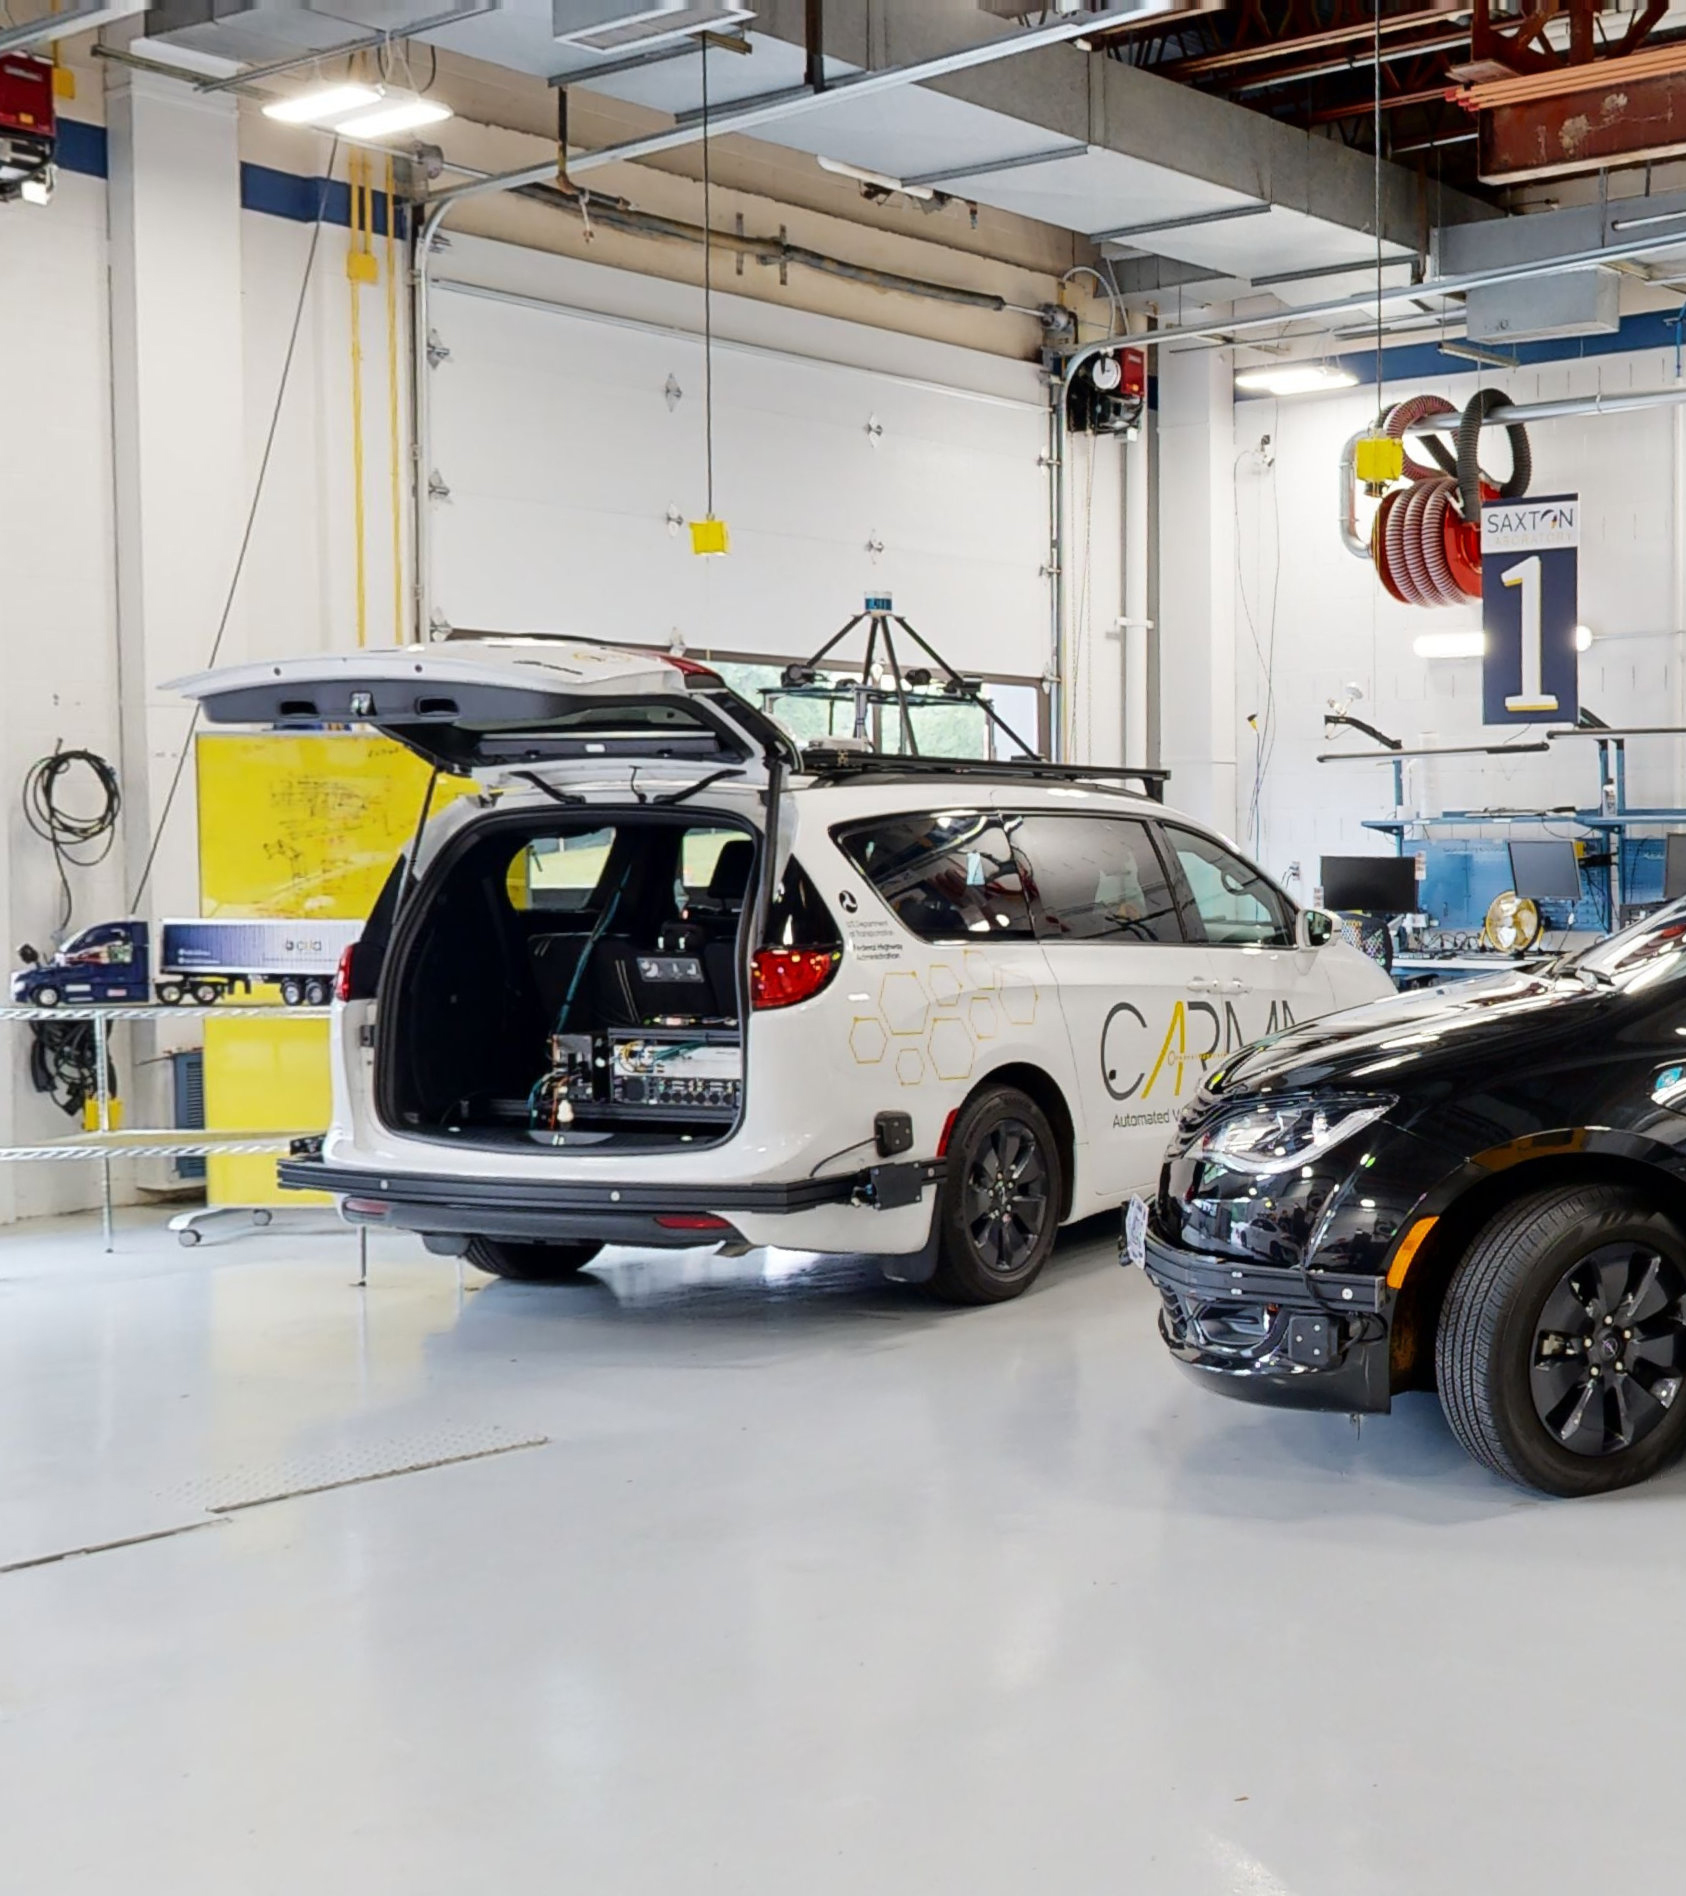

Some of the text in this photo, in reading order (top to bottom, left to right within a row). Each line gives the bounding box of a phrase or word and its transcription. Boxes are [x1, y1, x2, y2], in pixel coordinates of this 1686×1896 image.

[1487, 508, 1573, 534] SAXTON
[1501, 555, 1559, 712] 1
[1101, 1000, 1295, 1101] CARM
[1113, 1110, 1170, 1129] Automated
